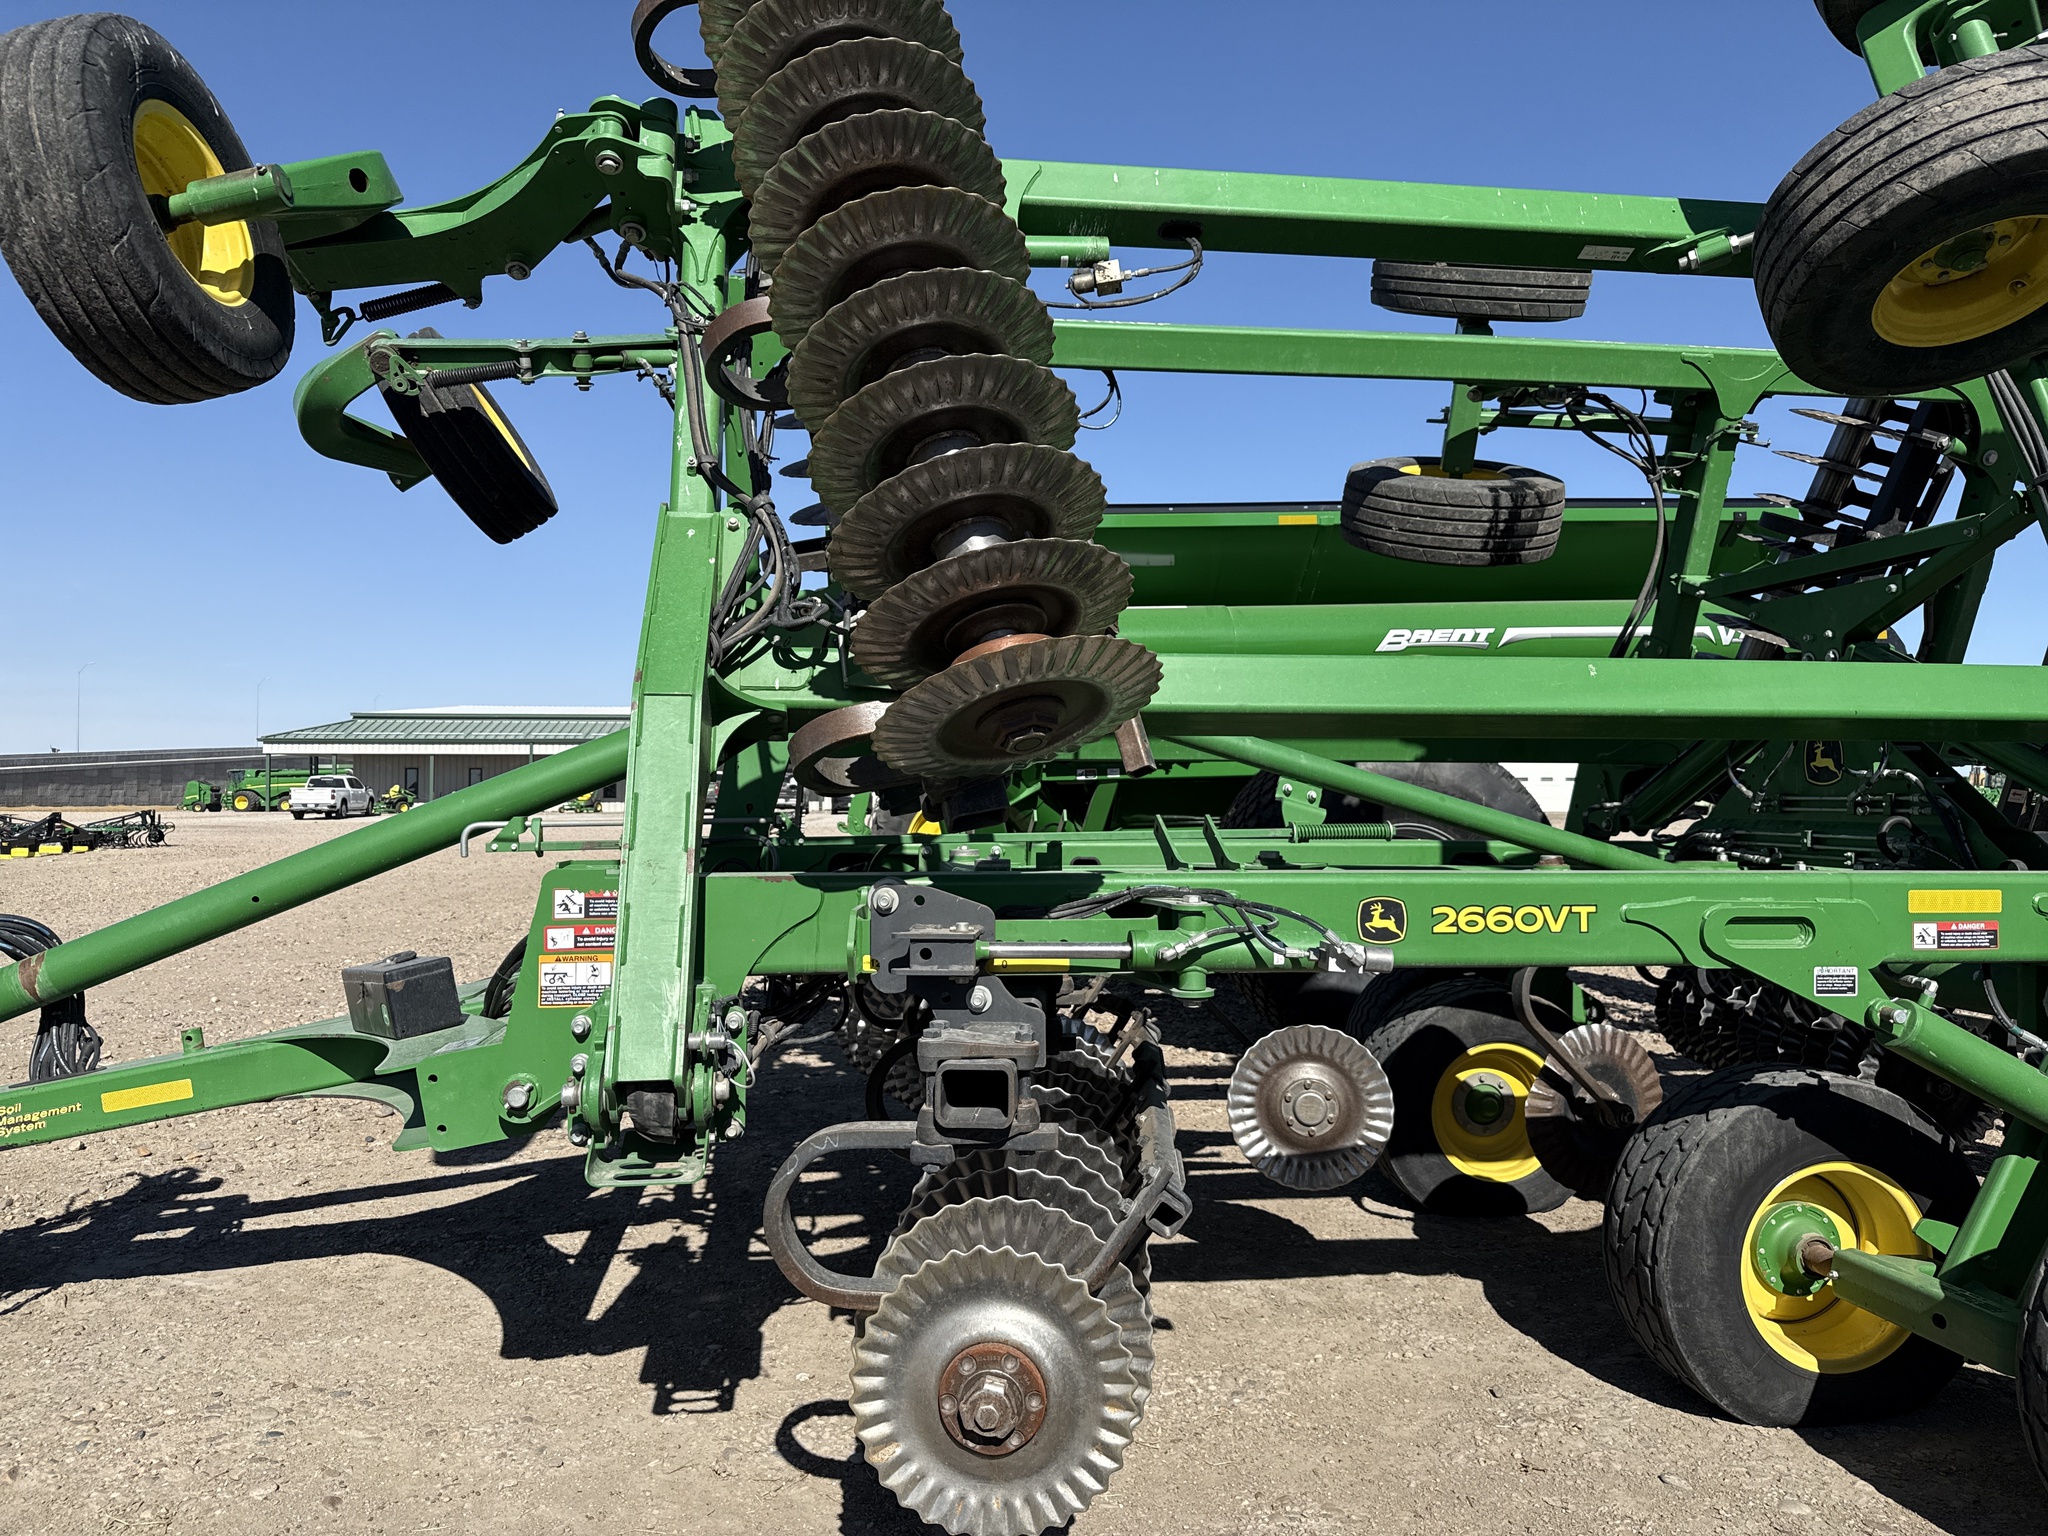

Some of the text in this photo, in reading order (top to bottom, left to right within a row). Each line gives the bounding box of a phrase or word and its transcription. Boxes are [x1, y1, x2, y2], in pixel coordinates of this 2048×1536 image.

[1374, 627, 1496, 653] BRENT
[1431, 904, 1597, 935] 2660VT
[0, 1102, 22, 1116] Soil
[0, 1102, 82, 1126] Management
[0, 1120, 46, 1138] System
